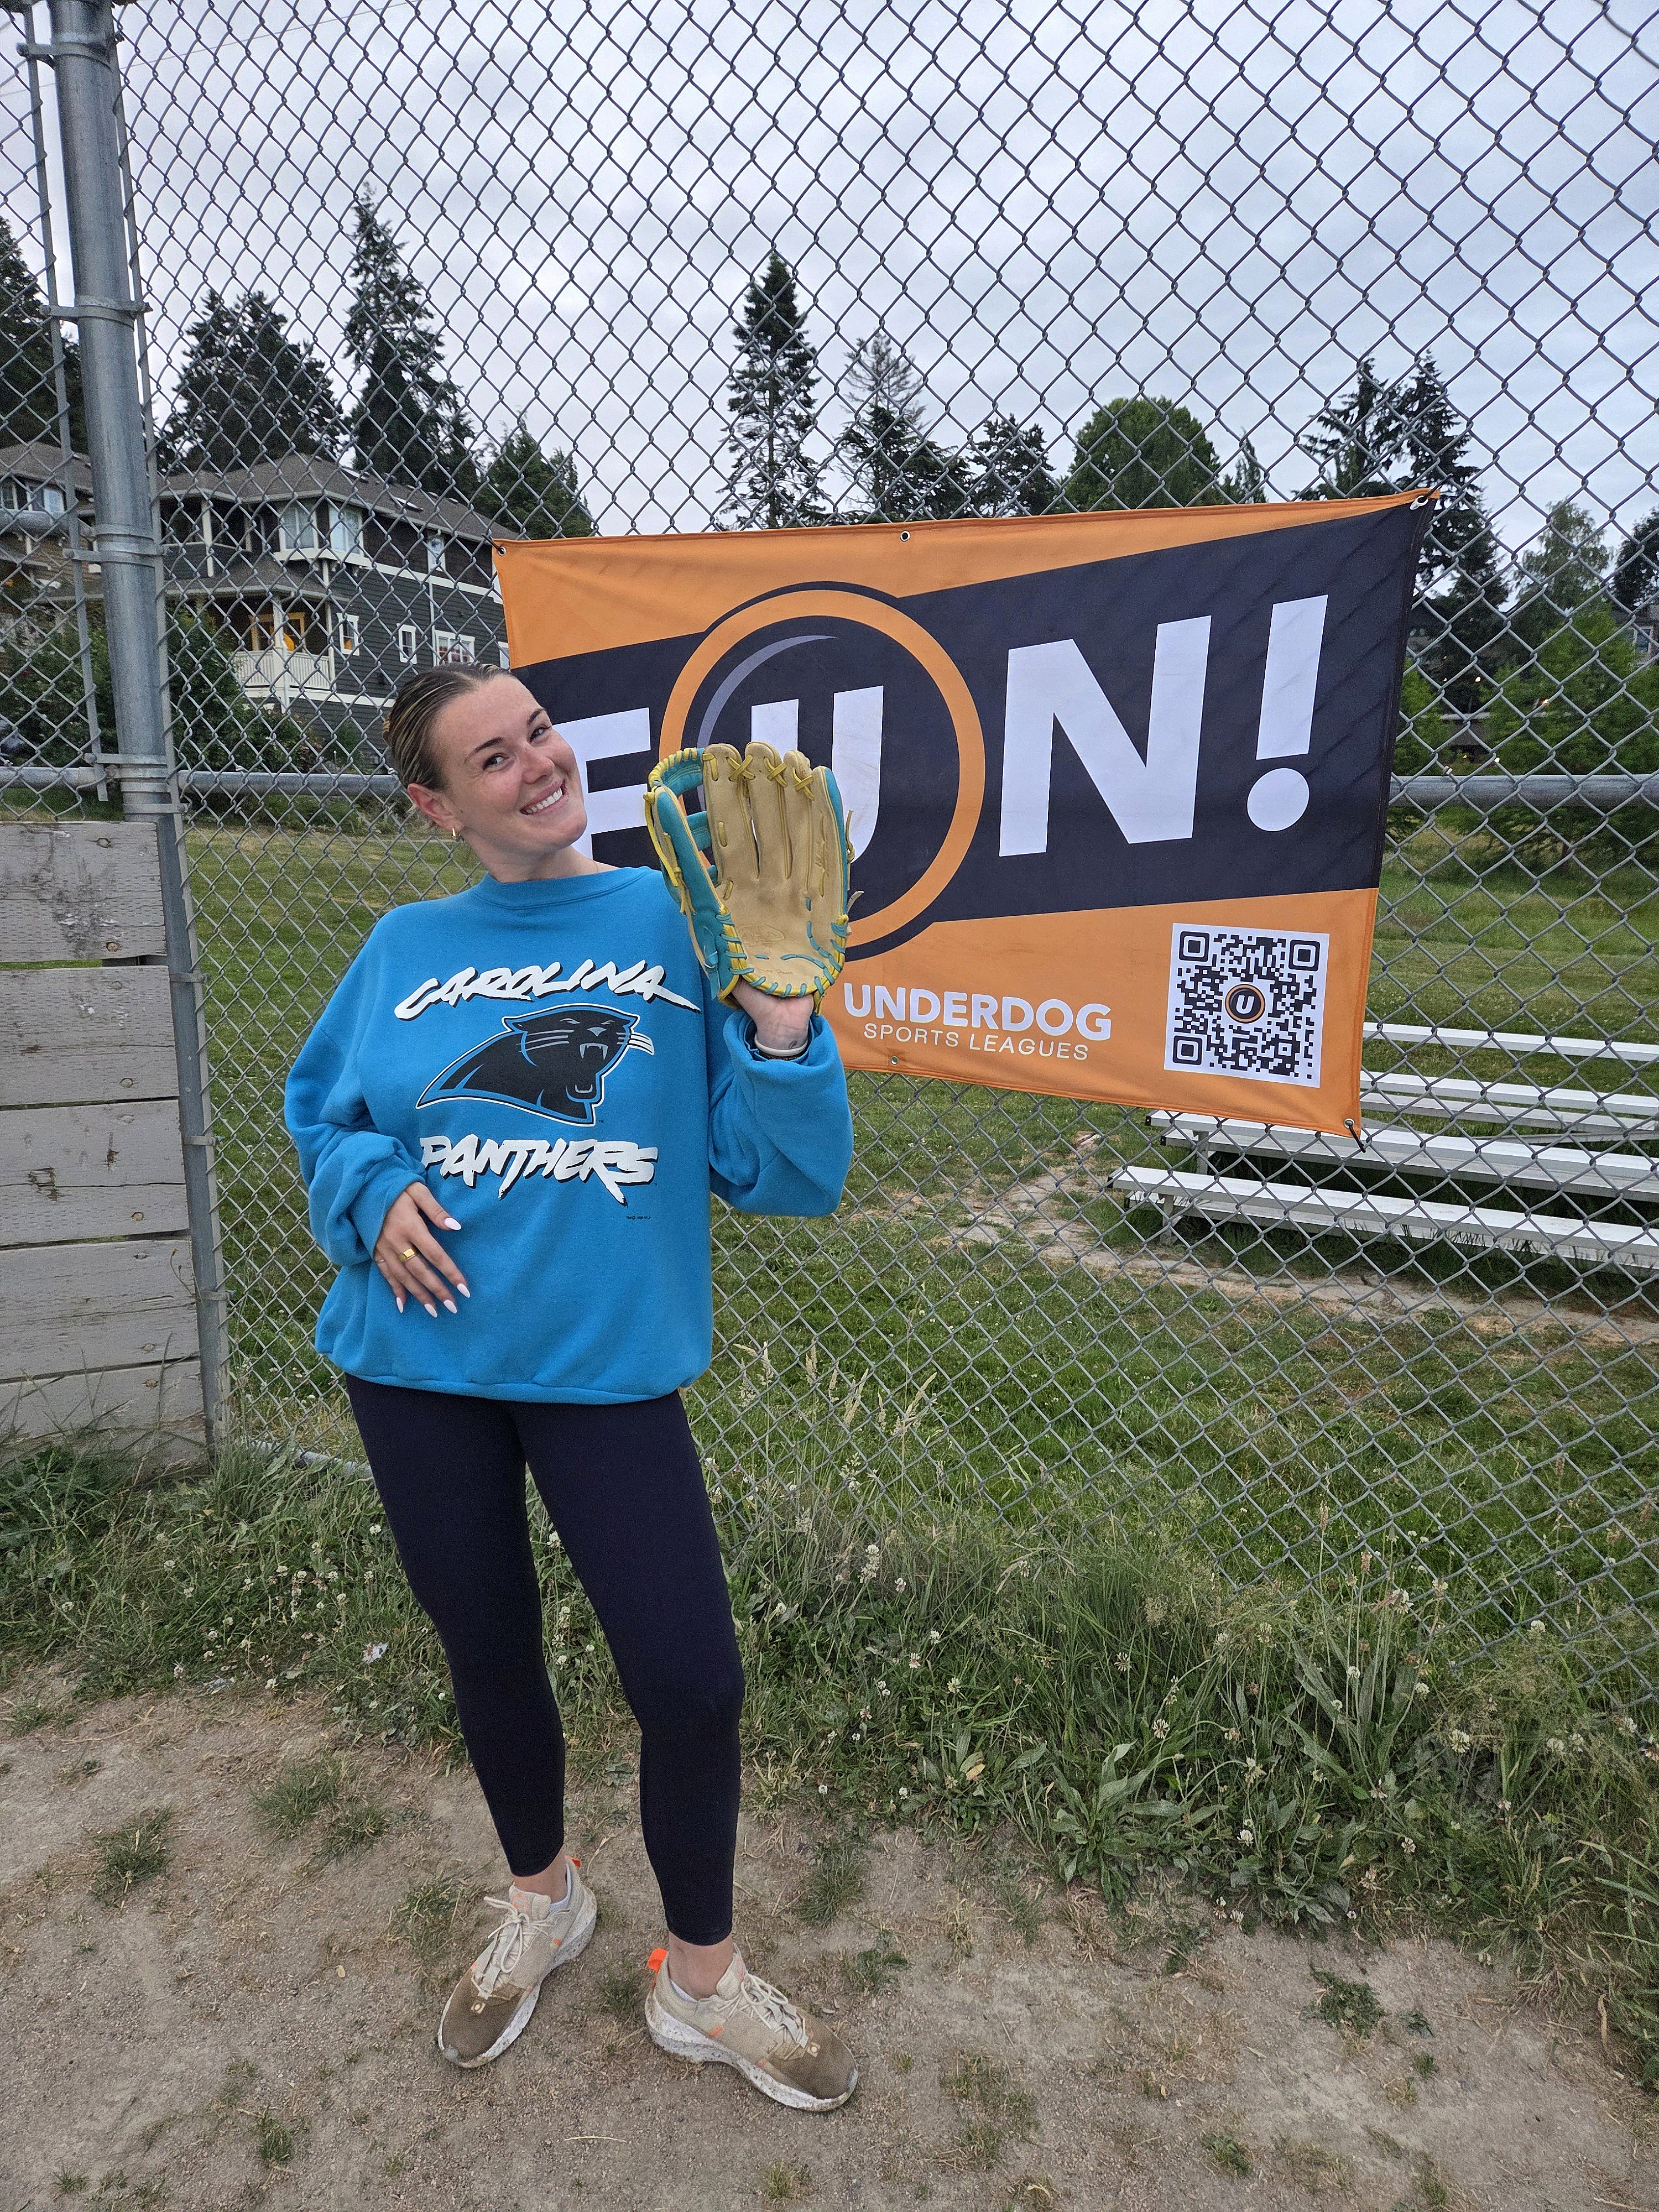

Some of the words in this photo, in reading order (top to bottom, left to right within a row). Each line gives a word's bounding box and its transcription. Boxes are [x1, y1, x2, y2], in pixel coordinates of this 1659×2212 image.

[394, 959, 701, 1021] CAROLINA
[843, 983, 1112, 1041] UNDERDOG
[1235, 995, 1255, 1014] U
[864, 1022, 959, 1047] SPORTS
[969, 1034, 1088, 1061] LEAGUES
[419, 1134, 658, 1207] PANTHERS
